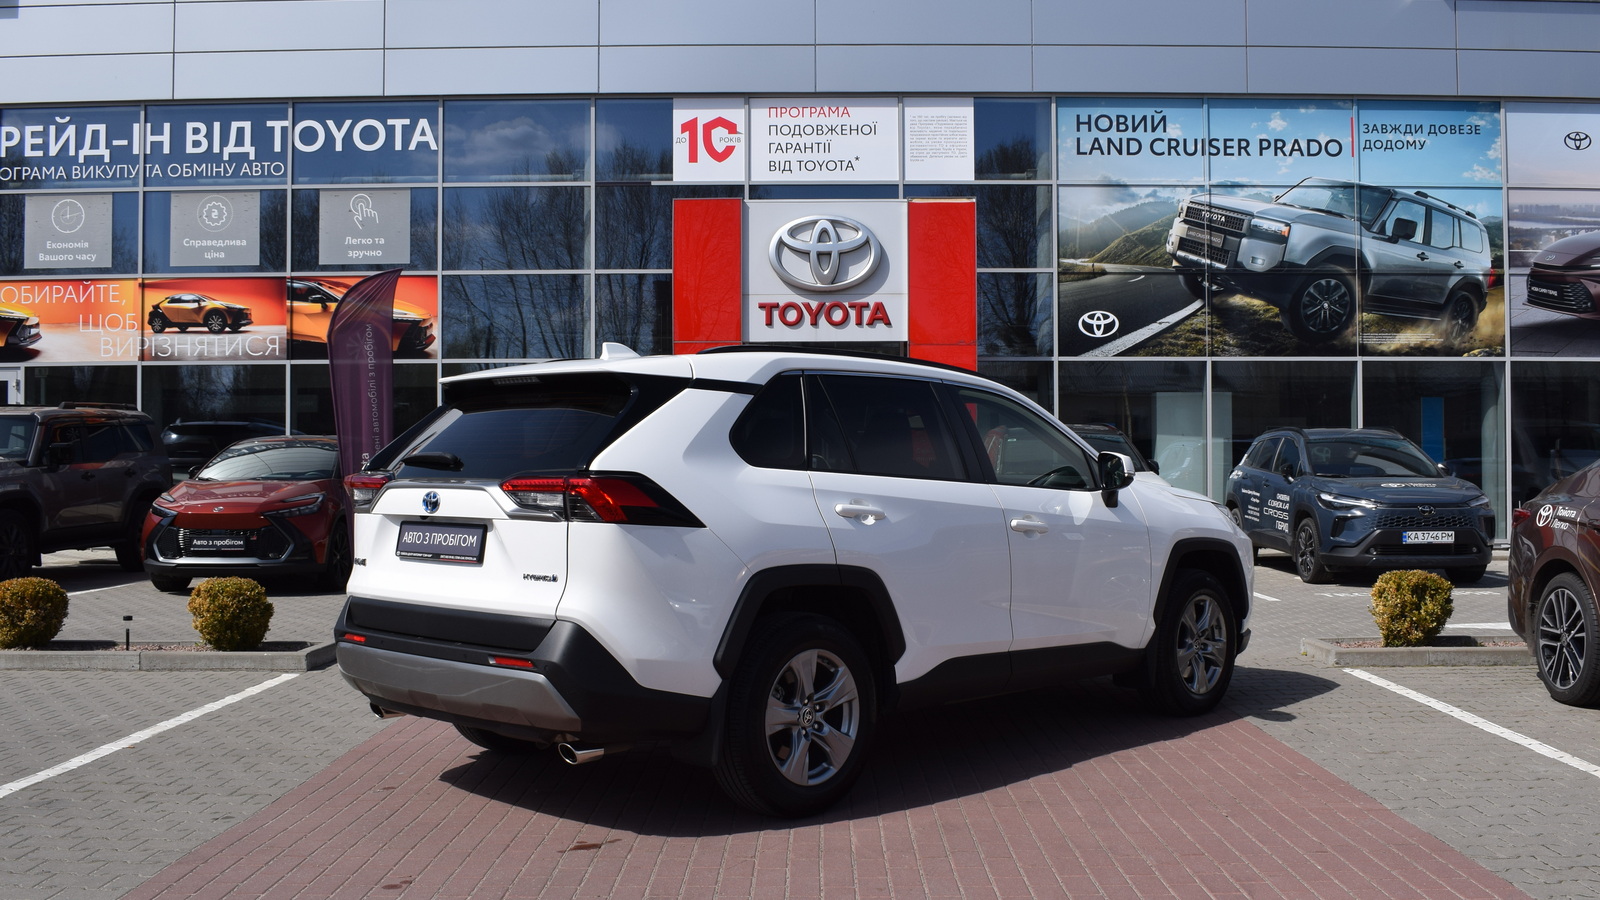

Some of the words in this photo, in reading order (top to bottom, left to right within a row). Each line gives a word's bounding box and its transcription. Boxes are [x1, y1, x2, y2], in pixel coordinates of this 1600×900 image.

[768, 106, 850, 118] ПРОГРАМА
[1075, 110, 1167, 133] НОВИЙ
[768, 121, 878, 138] ПОДОВЖЕНОЇ
[1362, 124, 1424, 136] ЗАВЖДИ
[1427, 124, 1481, 136] ДОВЕЗЕ
[186, 121, 255, 160] ВІД
[266, 118, 438, 153] TOYOTA
[1362, 139, 1427, 152] ДОДОМУ
[768, 139, 832, 154] ГАРАНТІЇ
[1075, 137, 1143, 156] LAND
[1150, 137, 1251, 157] CRUISER
[1258, 138, 1343, 158] PRADO
[72, 164, 139, 179] ВИКУПУ
[144, 163, 163, 178] ТА
[167, 162, 236, 177] ОБМІНУ
[240, 161, 285, 176] АВТО
[768, 160, 793, 174] ВІД
[46, 240, 89, 249] Економія
[183, 238, 247, 249] Справедлива
[345, 236, 373, 245] Легко
[374, 237, 385, 245] та
[38, 252, 74, 261] Вашого
[75, 253, 97, 262] часу
[204, 249, 225, 259] ціна
[347, 249, 382, 258] зручно
[758, 301, 892, 327] TOYOTA
[79, 313, 138, 335] ЩОБ
[101, 335, 280, 357] ВИРІЗНЯТИСЯ
[364, 324, 376, 369] пробігом
[368, 380, 380, 433] автомобілі
[1263, 507, 1289, 520] CROSS
[213, 538, 243, 547] пробігом
[402, 531, 423, 544] АВТО
[430, 533, 477, 547] ПРОБІГОМ
[1420, 533, 1440, 541] 3746
